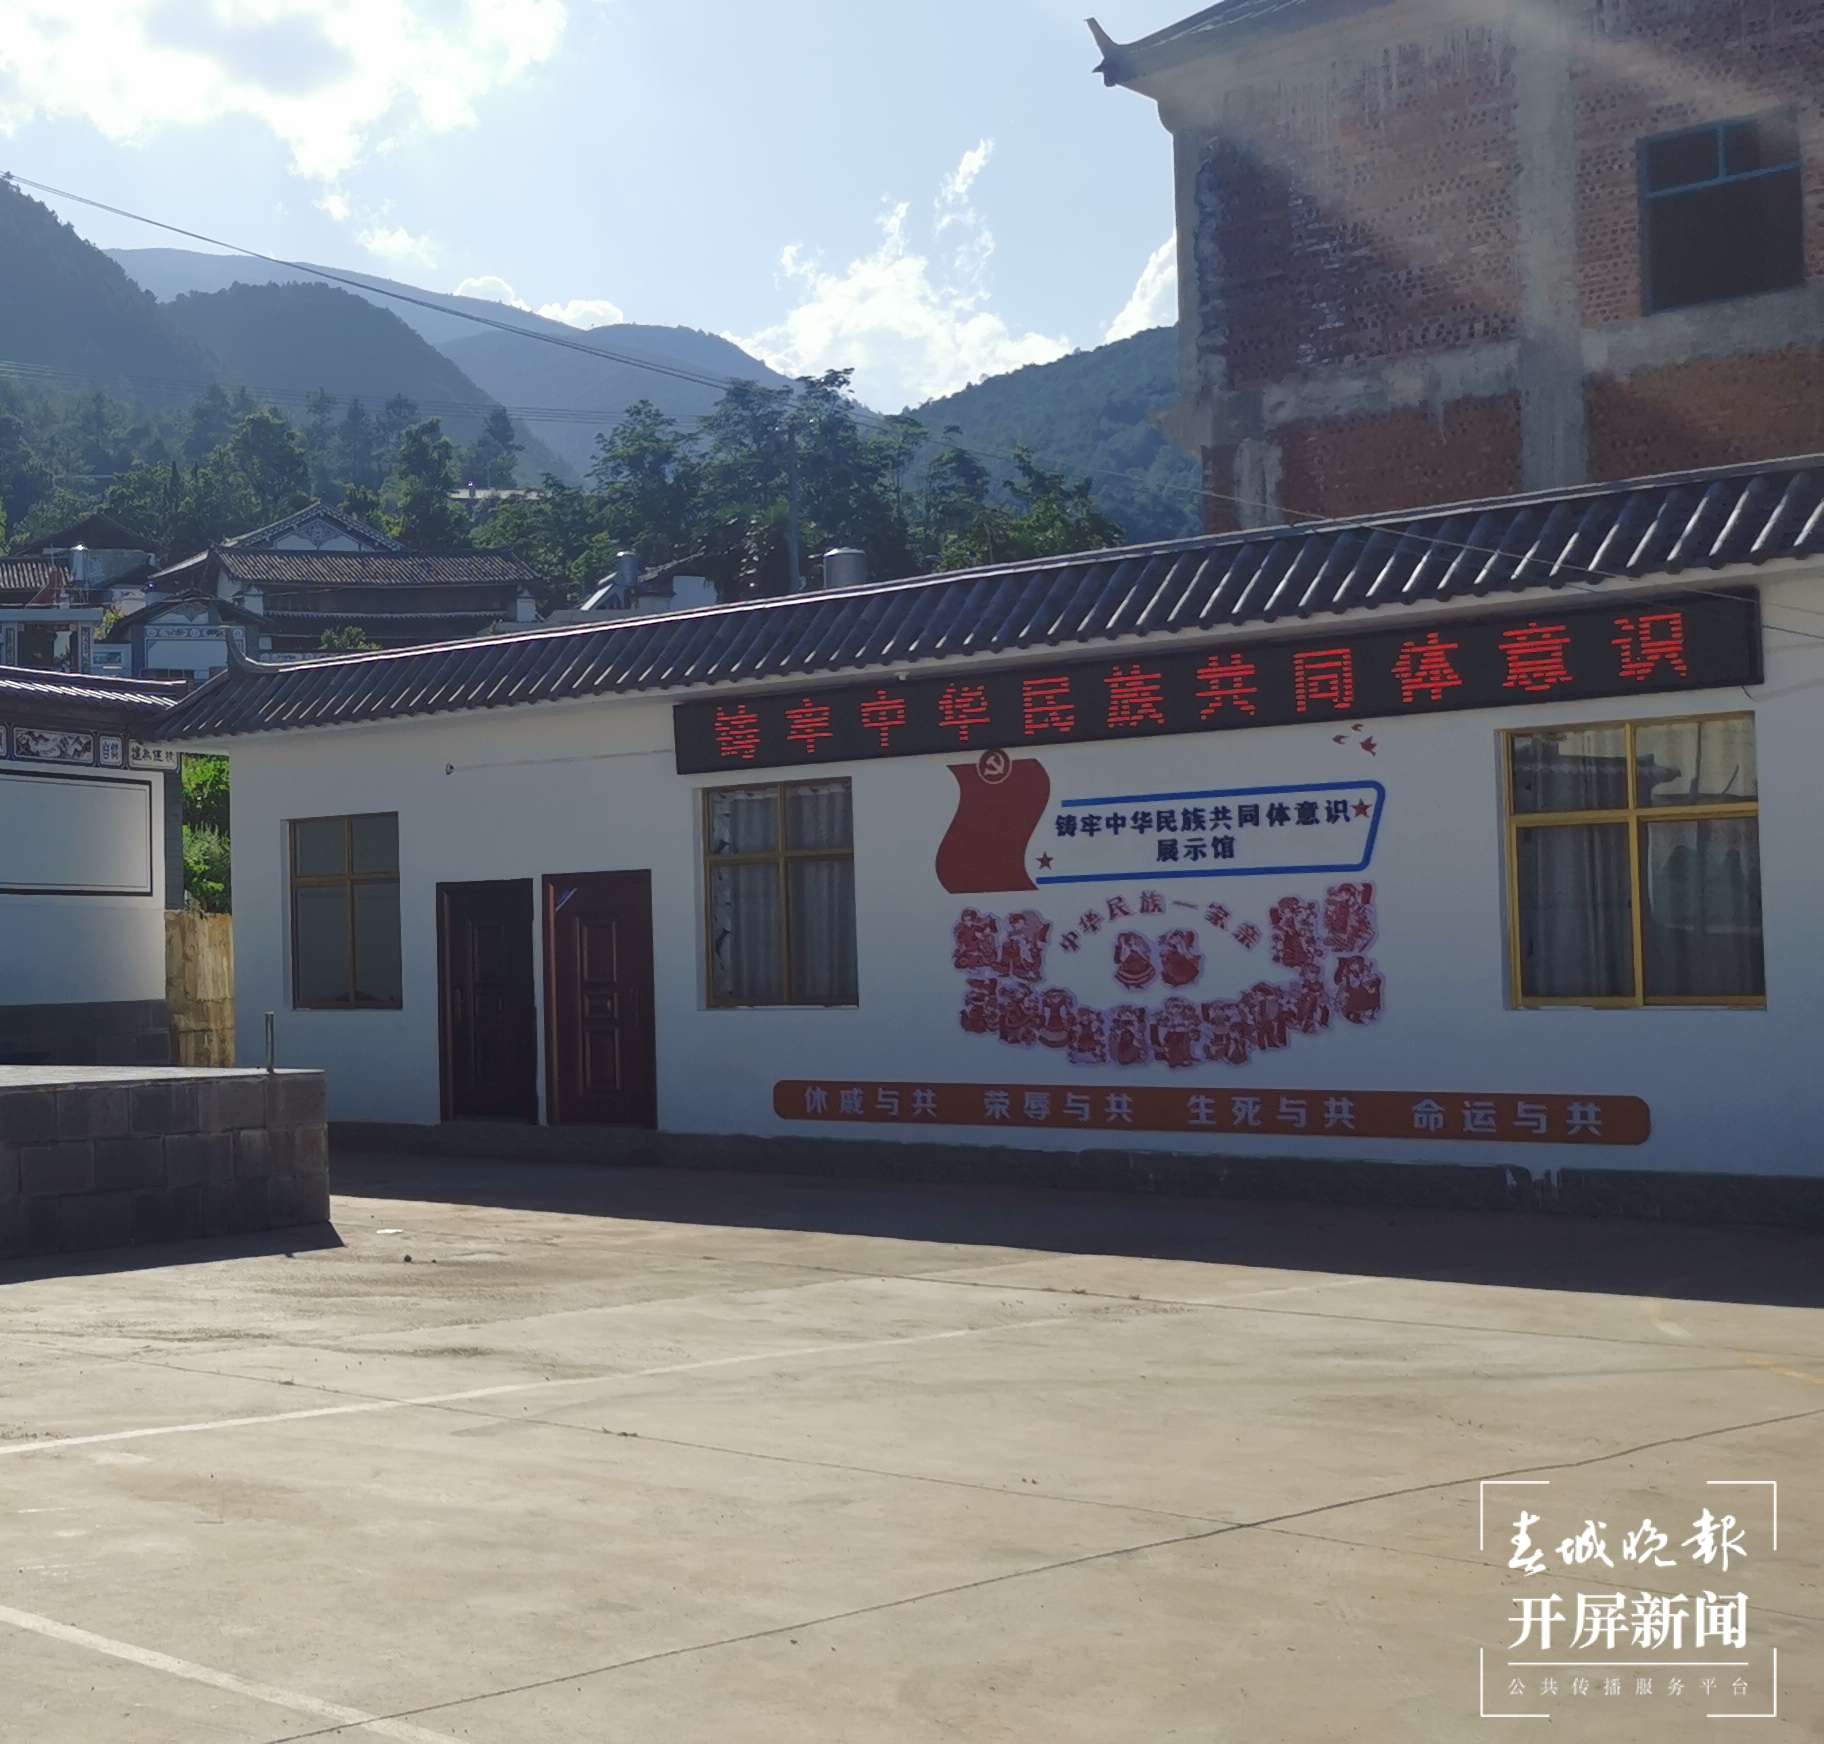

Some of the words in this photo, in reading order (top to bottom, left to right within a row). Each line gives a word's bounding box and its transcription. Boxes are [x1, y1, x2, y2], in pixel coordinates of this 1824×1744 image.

[714, 611, 1688, 759] 铸牢中华民族共同体意识
[1055, 799, 1351, 838] 铸牢中华民族共同体意识
[1156, 835, 1236, 863] 展示馆
[804, 1087, 937, 1118] 休戚与共
[983, 1090, 1134, 1123] 荣辱与共
[1188, 1095, 1356, 1131] 生死与共
[1411, 1098, 1604, 1138] 命运与共
